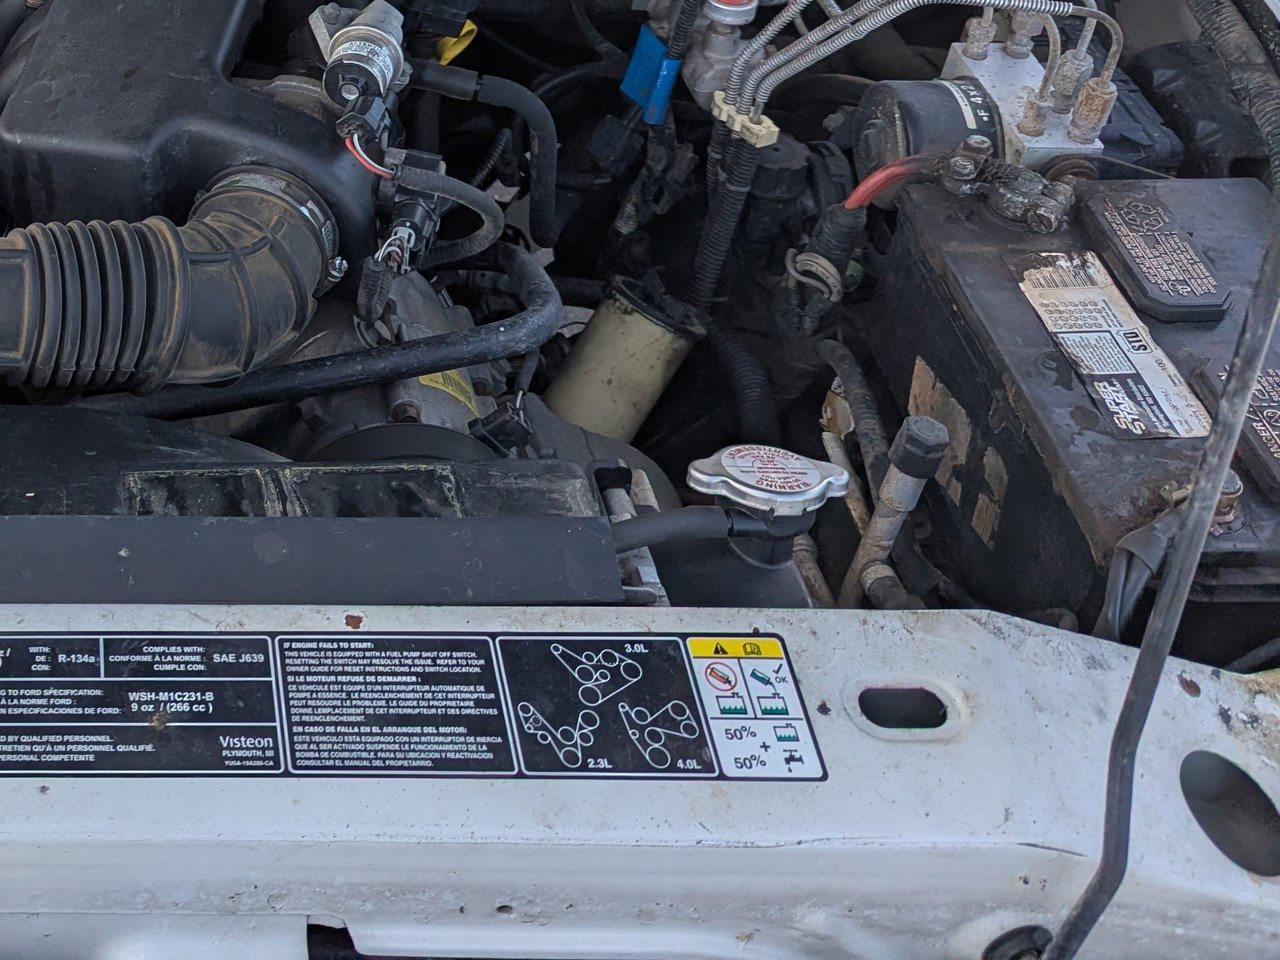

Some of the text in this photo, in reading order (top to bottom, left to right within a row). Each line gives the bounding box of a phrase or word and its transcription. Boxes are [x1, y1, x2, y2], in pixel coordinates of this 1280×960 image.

[1093, 381, 1130, 430] SUPER
[1107, 382, 1146, 435] START
[755, 480, 812, 491] WARNING
[624, 643, 649, 653] 3.0L
[58, 654, 95, 663] R-134a
[213, 654, 265, 663] SAE J639
[774, 676, 787, 684] OK
[128, 692, 214, 701] WSH-M1C231-B
[131, 703, 138, 711] 9
[166, 703, 190, 713] (266
[724, 726, 757, 740] 50%
[219, 736, 273, 748] Visteon
[587, 759, 613, 769] 2.3L
[677, 759, 702, 770] 4.0L
[734, 754, 767, 770] 50%
